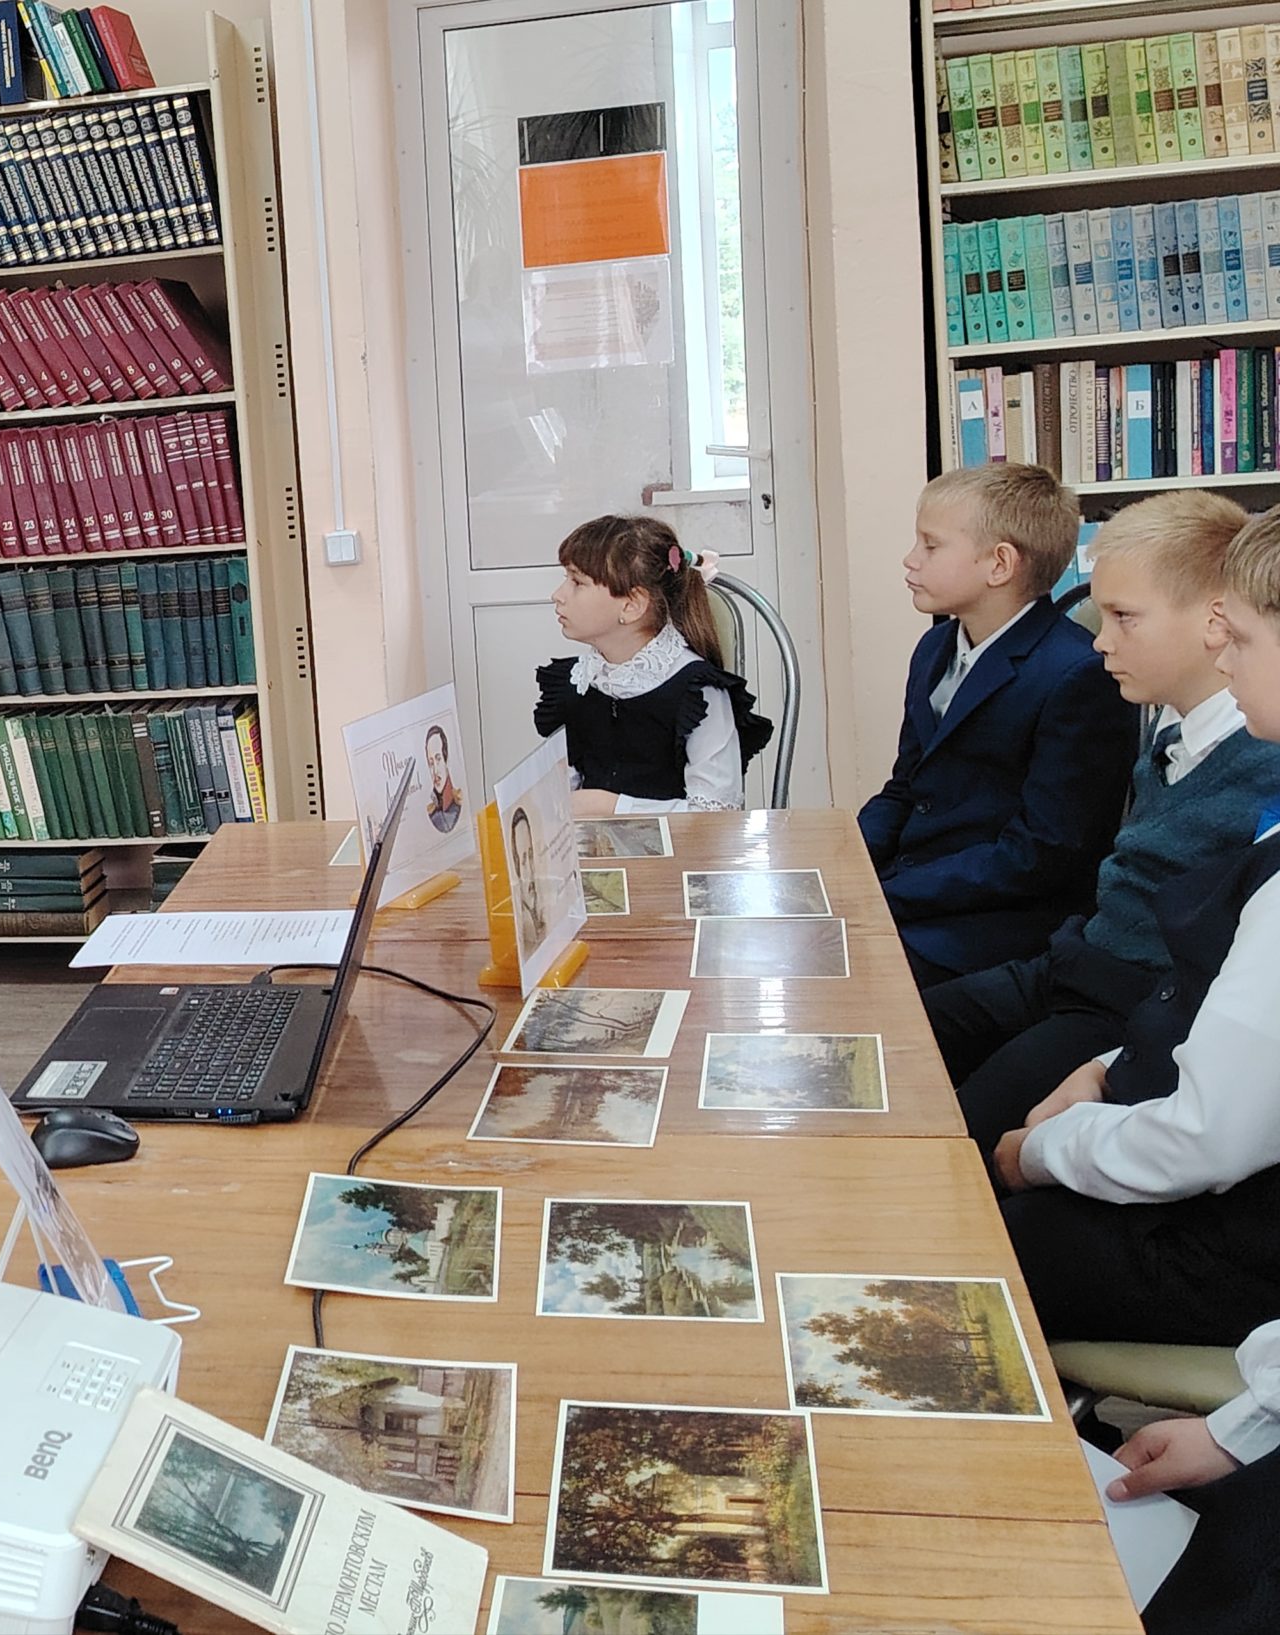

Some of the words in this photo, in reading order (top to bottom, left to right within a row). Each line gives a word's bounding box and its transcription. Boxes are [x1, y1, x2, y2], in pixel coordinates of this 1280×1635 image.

[141, 220, 151, 229] 21
[155, 218, 166, 228] 22
[173, 216, 183, 226] 23
[186, 215, 197, 224] 24
[94, 225, 104, 234] 18
[109, 223, 119, 233] 19
[125, 222, 135, 231] 20
[30, 232, 40, 242] 14
[47, 231, 57, 240] 15
[63, 230, 73, 239] 16
[77, 228, 87, 237] 17
[15, 234, 24, 244] 13
[148, 362, 157, 373] 9
[171, 359, 182, 370] 10
[194, 357, 205, 368] 11
[60, 369, 69, 380] 5
[82, 367, 91, 377] 6
[104, 365, 113, 376] 7
[126, 365, 135, 375] 8
[18, 374, 27, 384] 3
[40, 371, 49, 381] 4
[1066, 368, 1079, 433] ОТРОЧЕСТВО
[1135, 400, 1145, 411] Б
[103, 513, 115, 525] 26
[123, 511, 134, 522] 27
[143, 510, 155, 521] 28
[161, 509, 173, 520] 30
[2, 520, 13, 531] 22
[24, 520, 35, 530] 23
[44, 519, 55, 530] 24
[64, 517, 76, 529] 24
[84, 516, 95, 527] 25
[242, 745, 254, 767] ТЕЛО
[247, 770, 259, 793] СВОЕ
[24, 1430, 73, 1480] BenQ
[330, 1508, 377, 1624] ЛЕРМОНТОВСКИМ
[358, 1558, 389, 1617] МЕСТАМ
